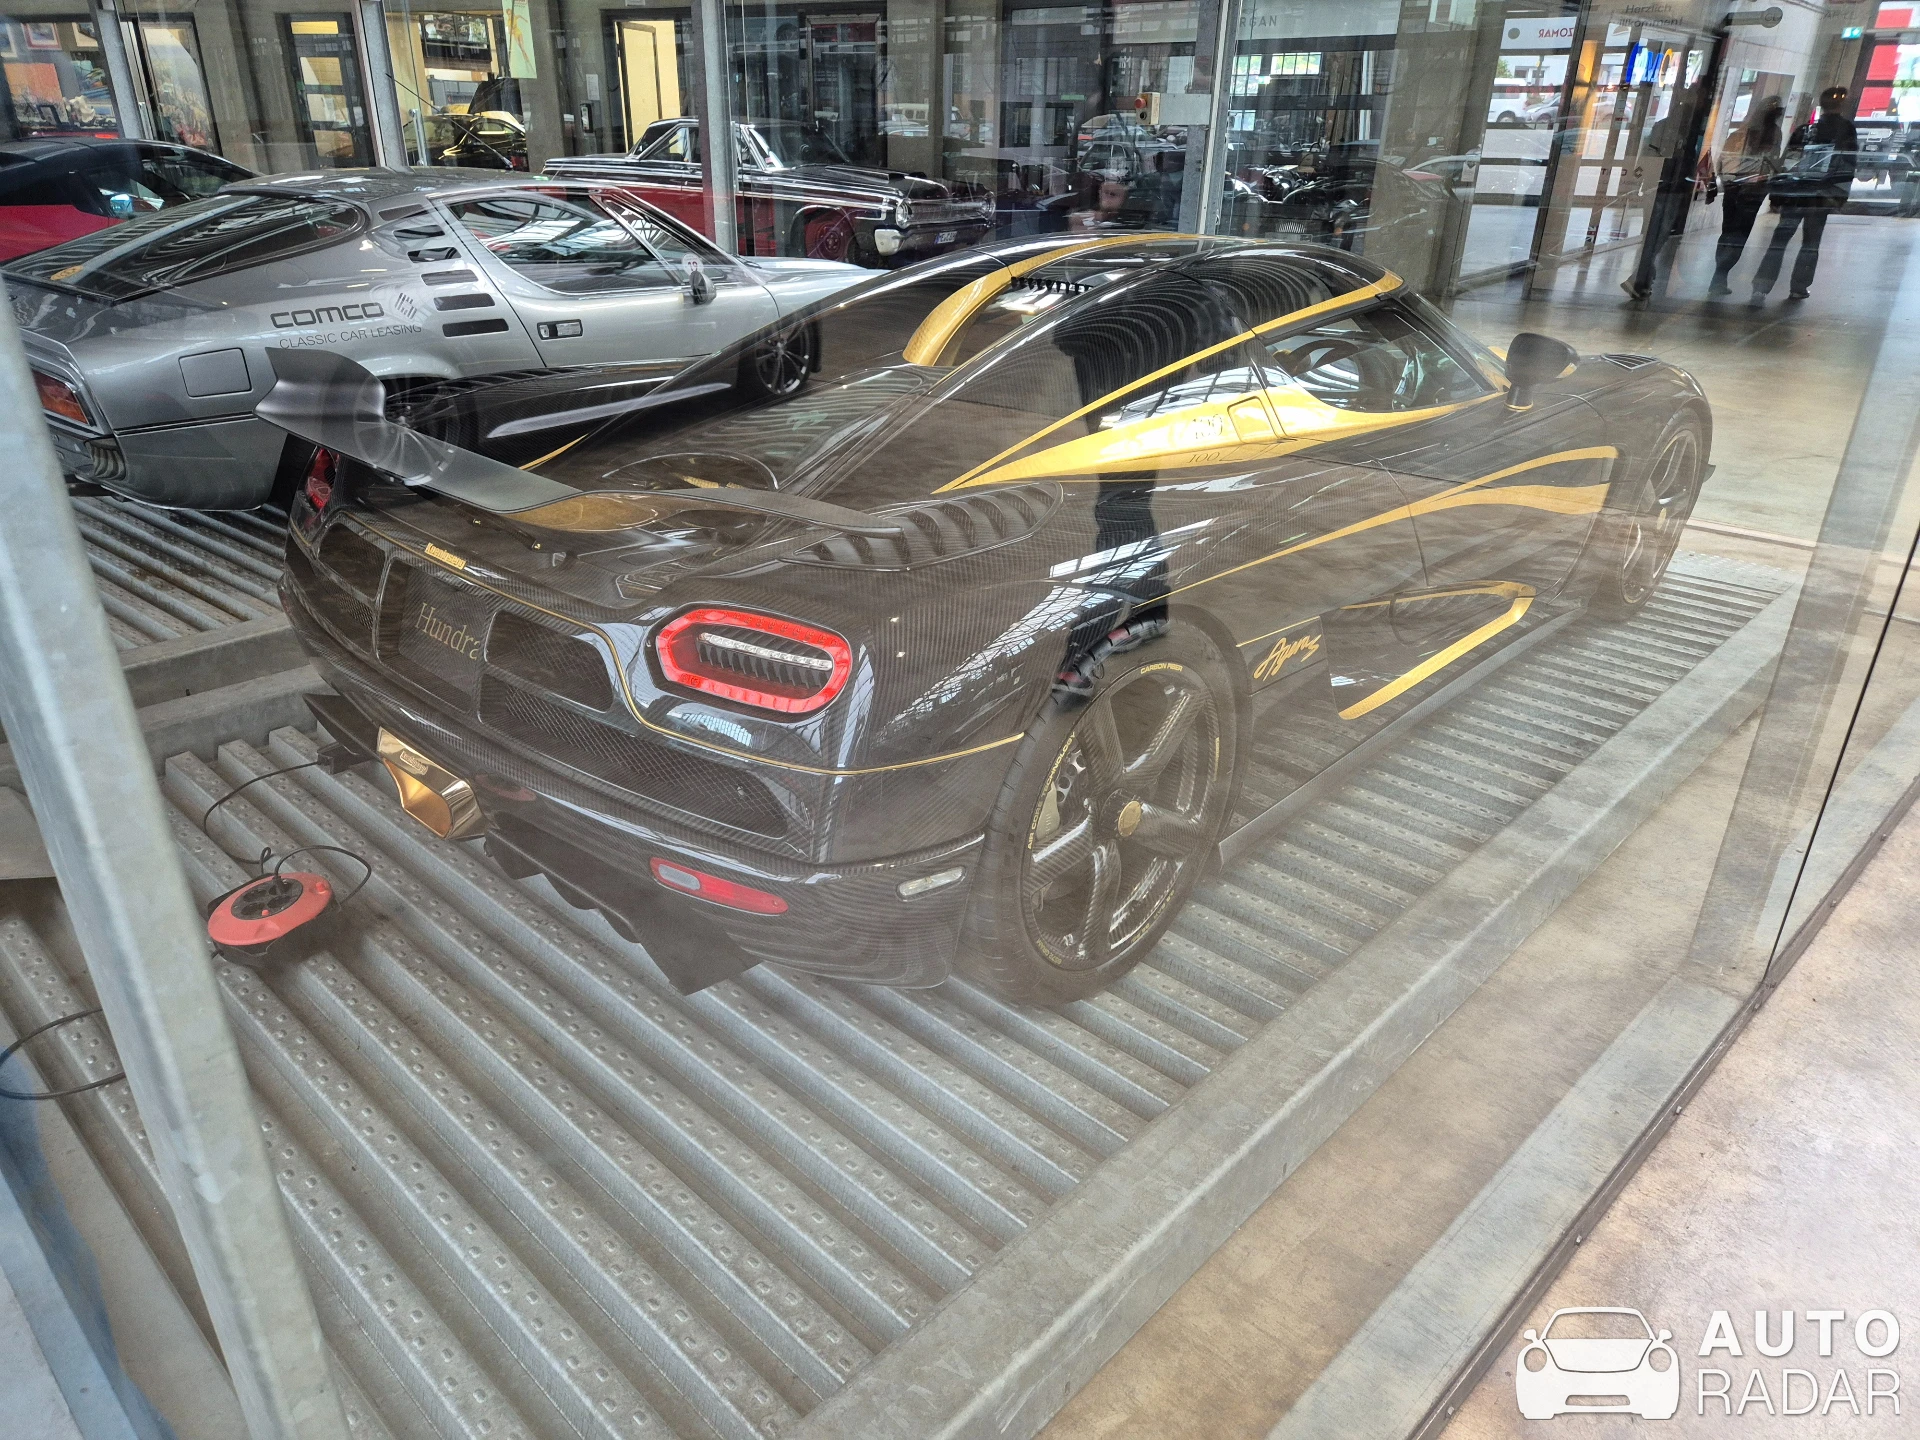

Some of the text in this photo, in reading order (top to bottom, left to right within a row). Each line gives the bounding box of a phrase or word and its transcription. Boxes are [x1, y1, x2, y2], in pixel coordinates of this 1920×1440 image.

[1625, 3, 1672, 14] Herzlich
[1239, 15, 1277, 28] RGAN
[279, 324, 422, 350] CLASSIC CAR LEASING
[1141, 662, 1167, 674] CARBON
